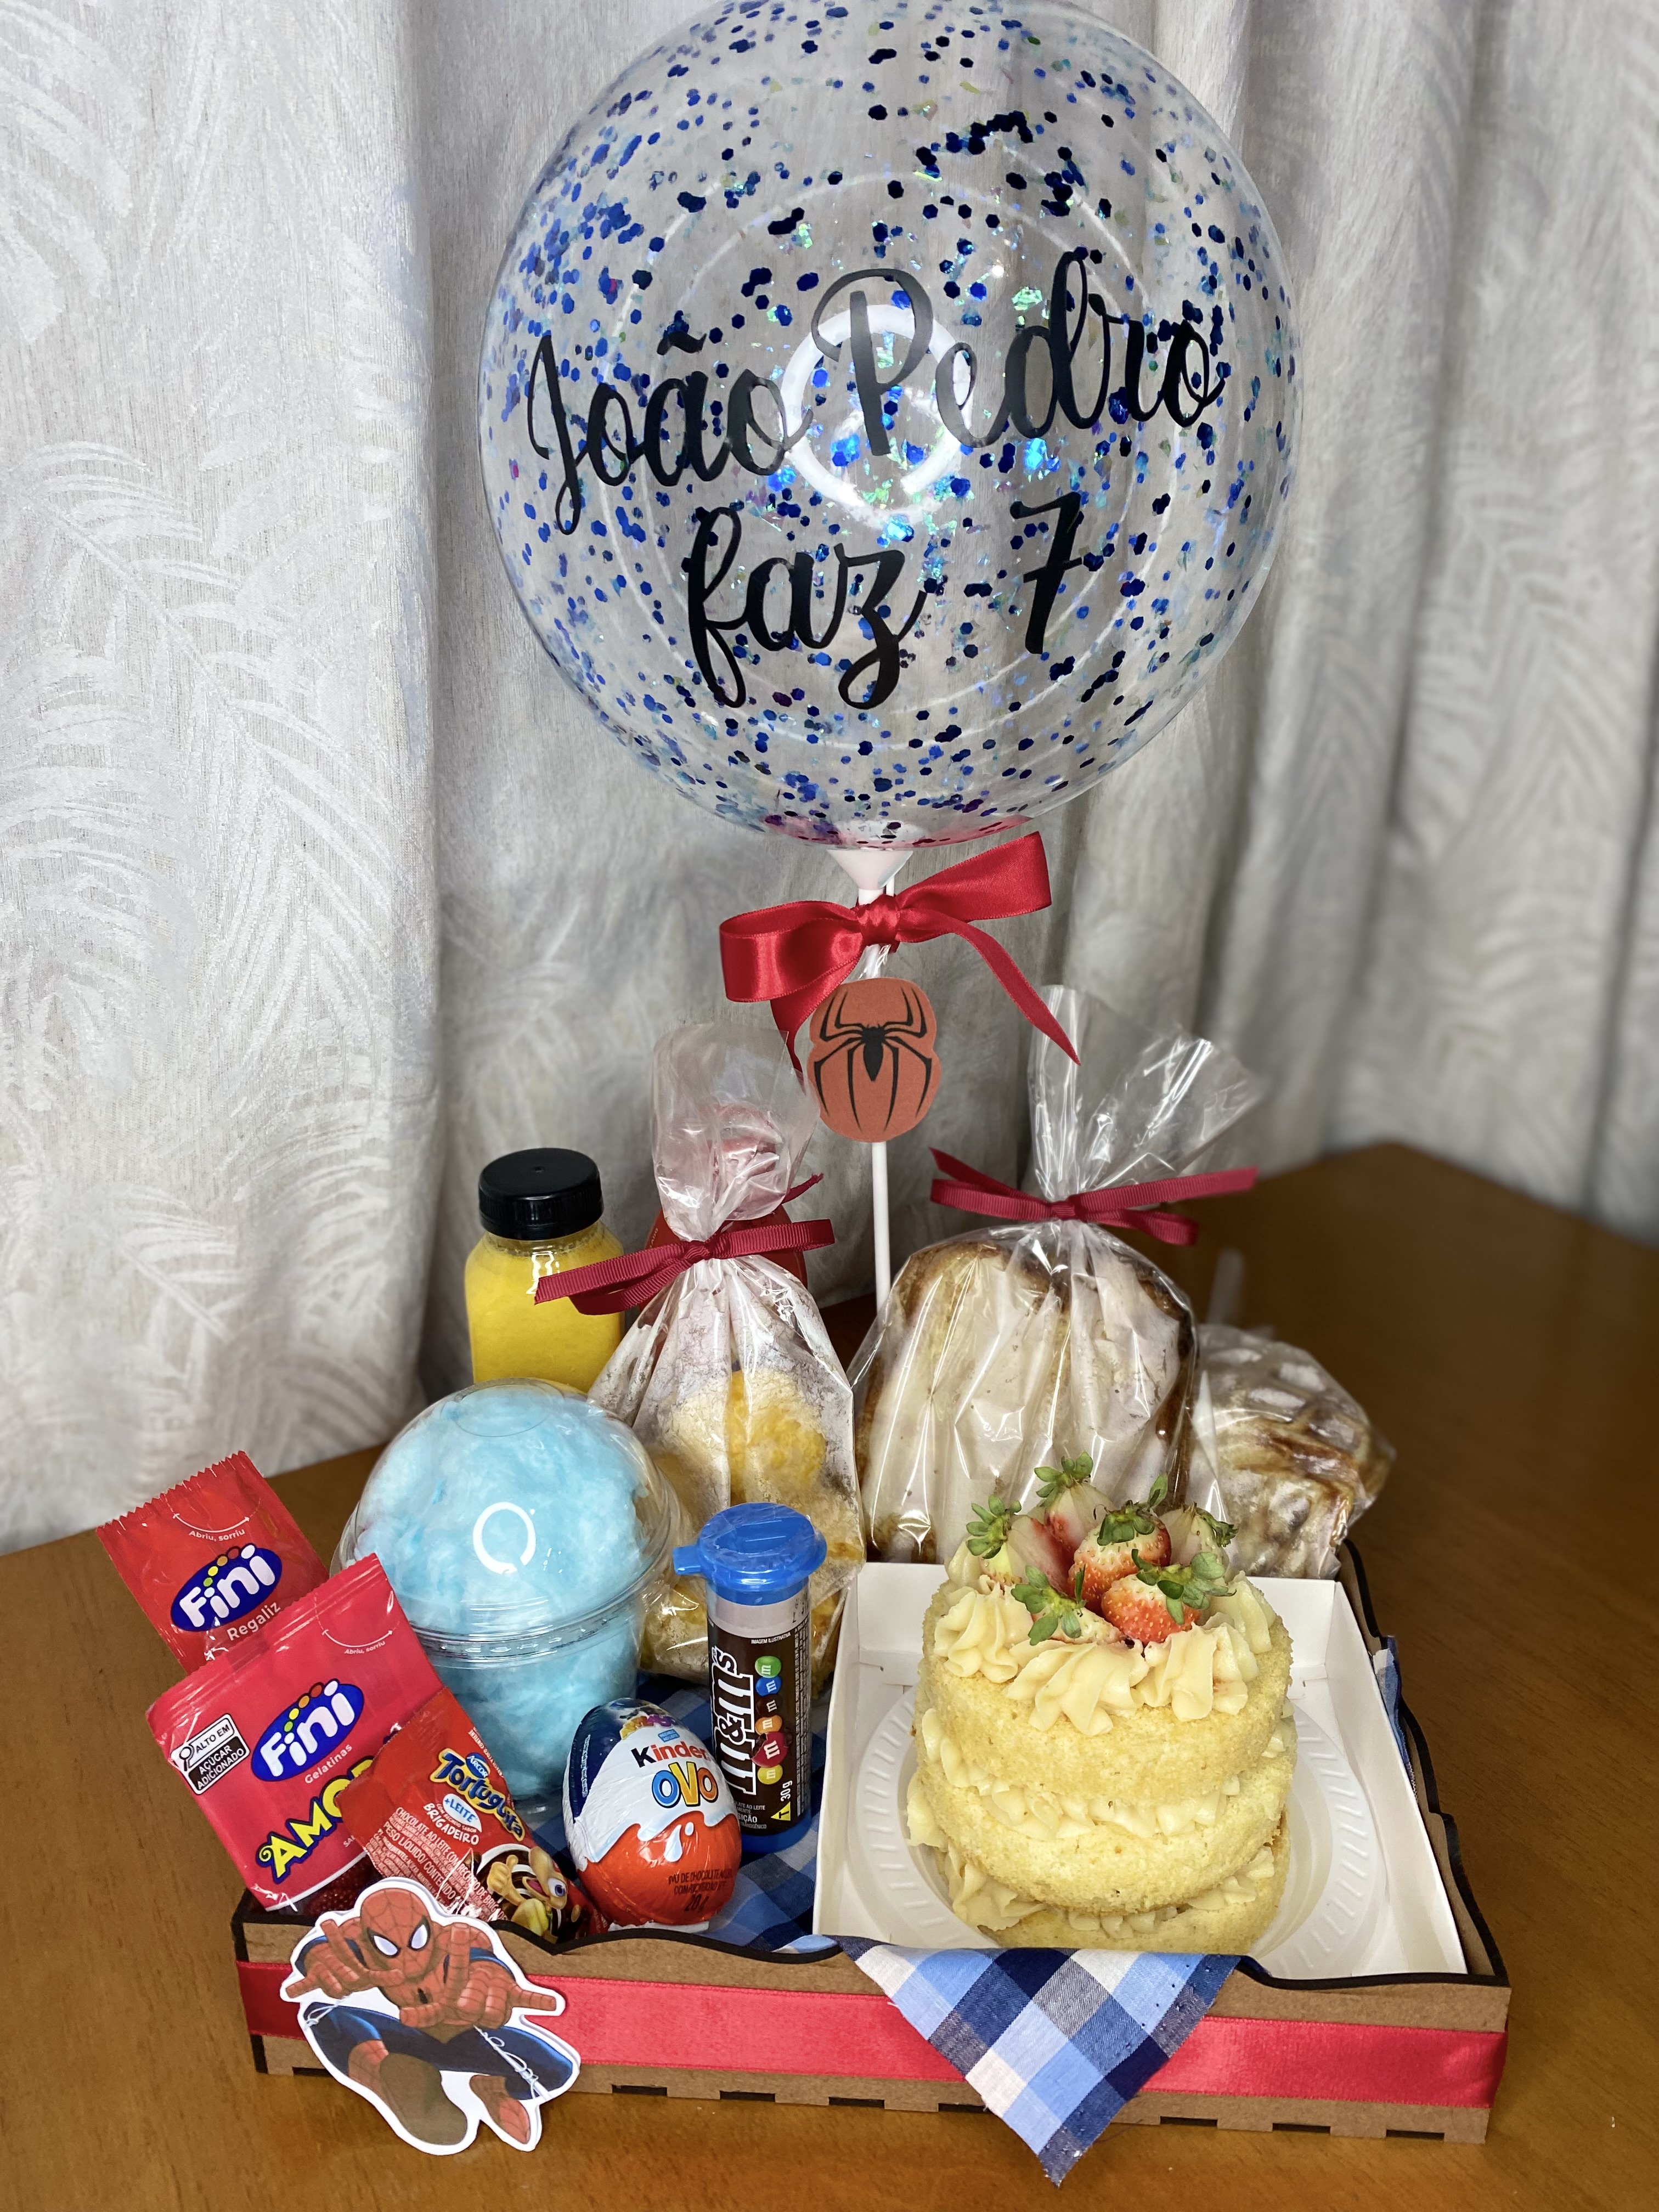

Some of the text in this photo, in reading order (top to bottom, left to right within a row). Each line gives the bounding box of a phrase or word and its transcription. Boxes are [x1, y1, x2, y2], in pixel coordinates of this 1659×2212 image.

[528, 250, 1229, 535] João Pedro
[687, 492, 1084, 709] faz 7
[189, 1530, 245, 1542] Abriu, sorriu
[179, 1544, 275, 1627] Fini
[227, 1602, 281, 1641] Regaliz
[768, 1632, 791, 1643] ILUSTRATIVA
[366, 1641, 385, 1652] sorriu
[196, 1724, 230, 1753] ALTO EM
[260, 1680, 356, 1776] Fini
[197, 1748, 244, 1790] ADICIONADO
[199, 1745, 232, 1775] AÇÚCAR
[304, 1744, 352, 1784] Gelatinas
[467, 1756, 488, 1778] ARCOR
[631, 1741, 707, 1768] Kinder
[435, 1752, 523, 1838] Tortuguita
[652, 1761, 719, 1809] OVO
[259, 1759, 374, 1878] AMO
[383, 1821, 400, 1841] PESO
[423, 1803, 478, 1845] BRIGADEIRO
[779, 1810, 789, 1819] T
[396, 1807, 429, 1835] CHOCOLATE
[426, 1831, 438, 1840] AO
[436, 1837, 451, 1855] LEITE
[476, 1887, 487, 1898] DE
